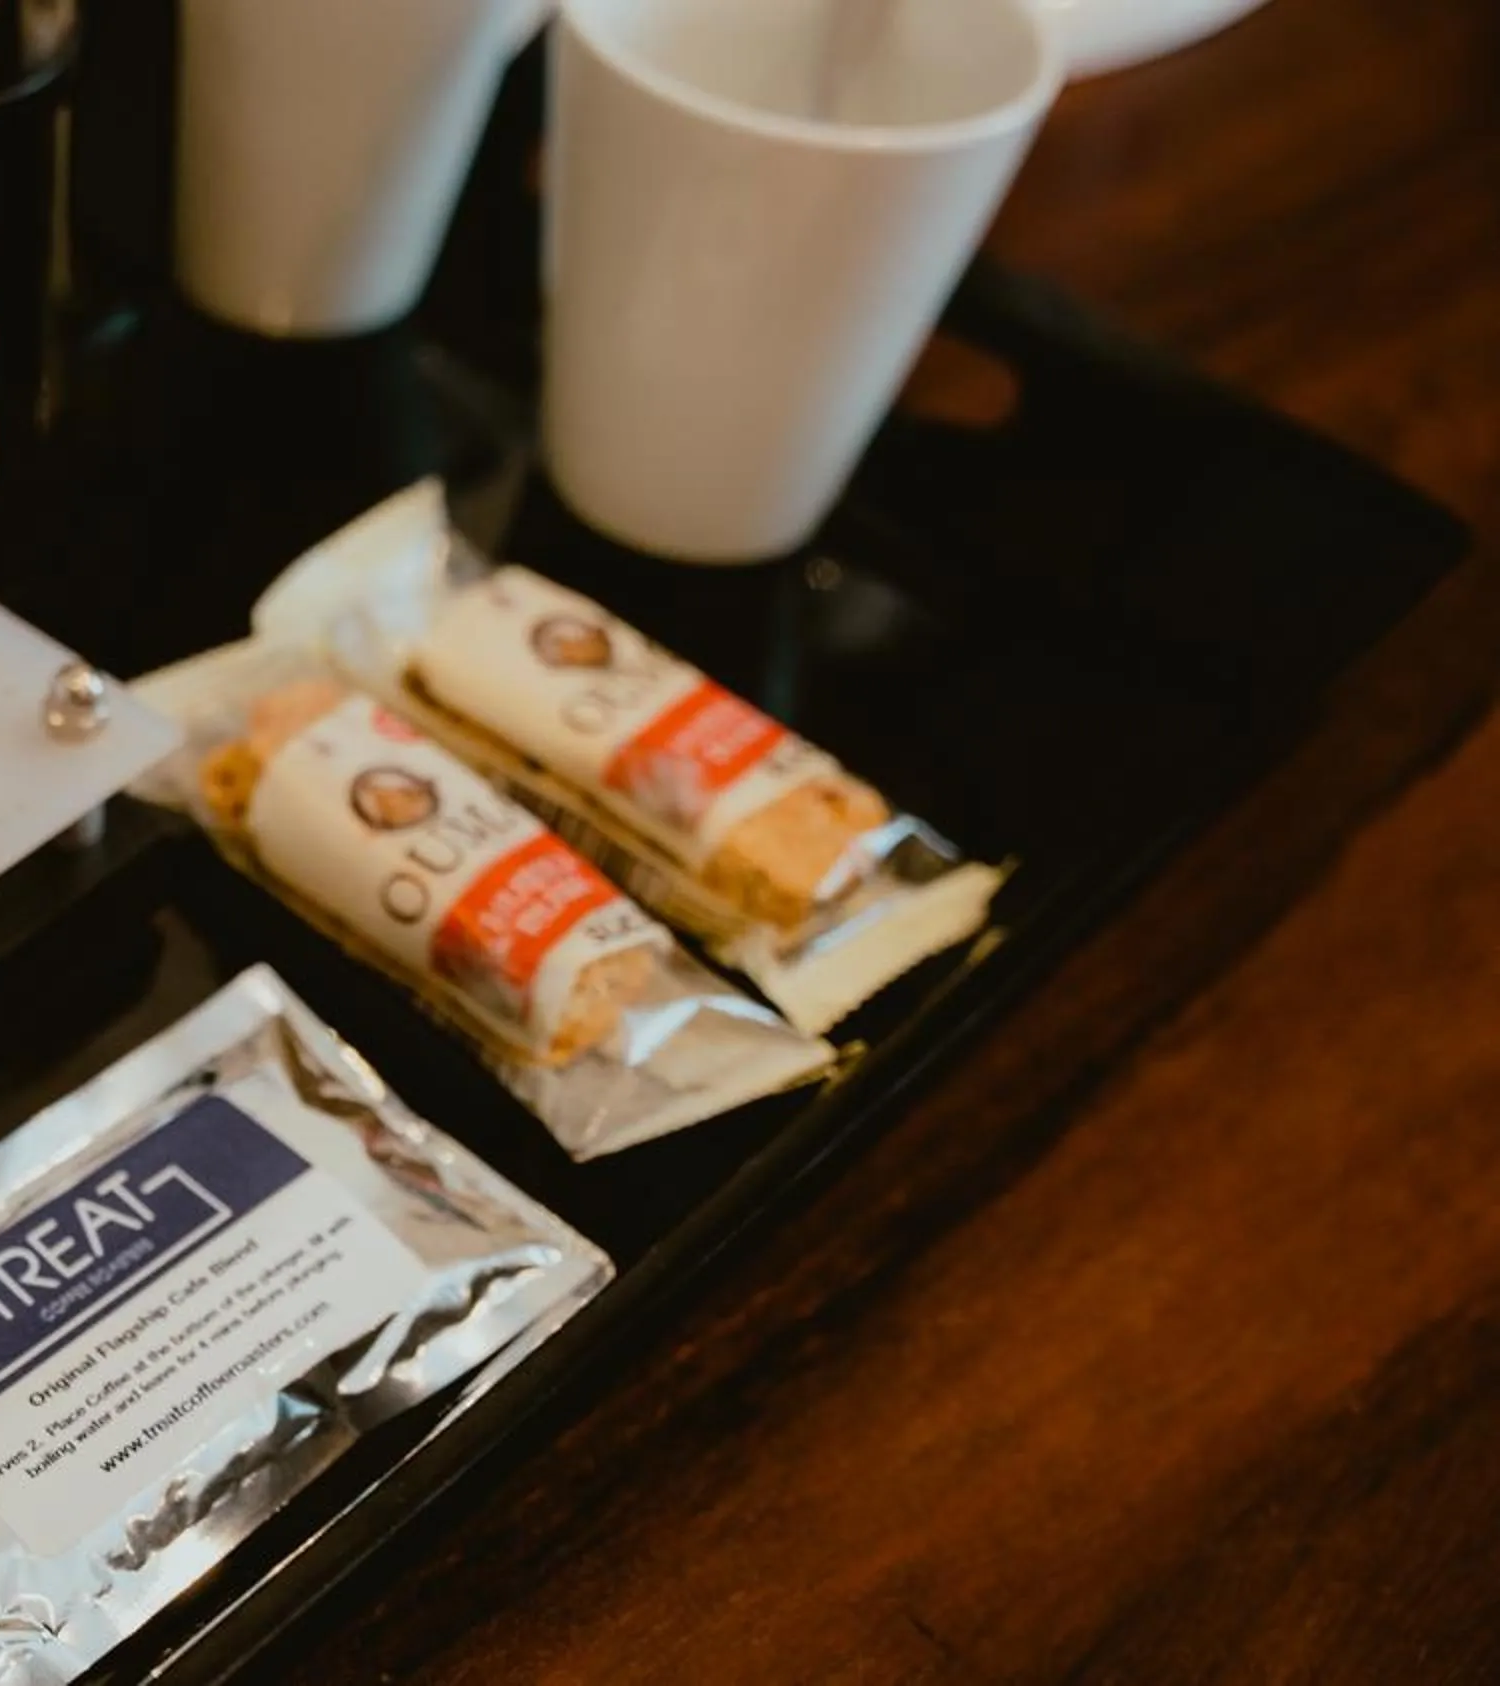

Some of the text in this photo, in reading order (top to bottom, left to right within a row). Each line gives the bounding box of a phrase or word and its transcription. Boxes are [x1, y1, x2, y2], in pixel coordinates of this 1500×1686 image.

[27, 1353, 96, 1407] Original
[95, 1304, 168, 1358] Flagship
[45, 1407, 86, 1436] Place
[84, 1372, 133, 1407] Coffee
[132, 1360, 146, 1374] at
[147, 1344, 170, 1362] the
[25, 1442, 75, 1478] boiling
[74, 1412, 111, 1442] water
[113, 1389, 140, 1414] and
